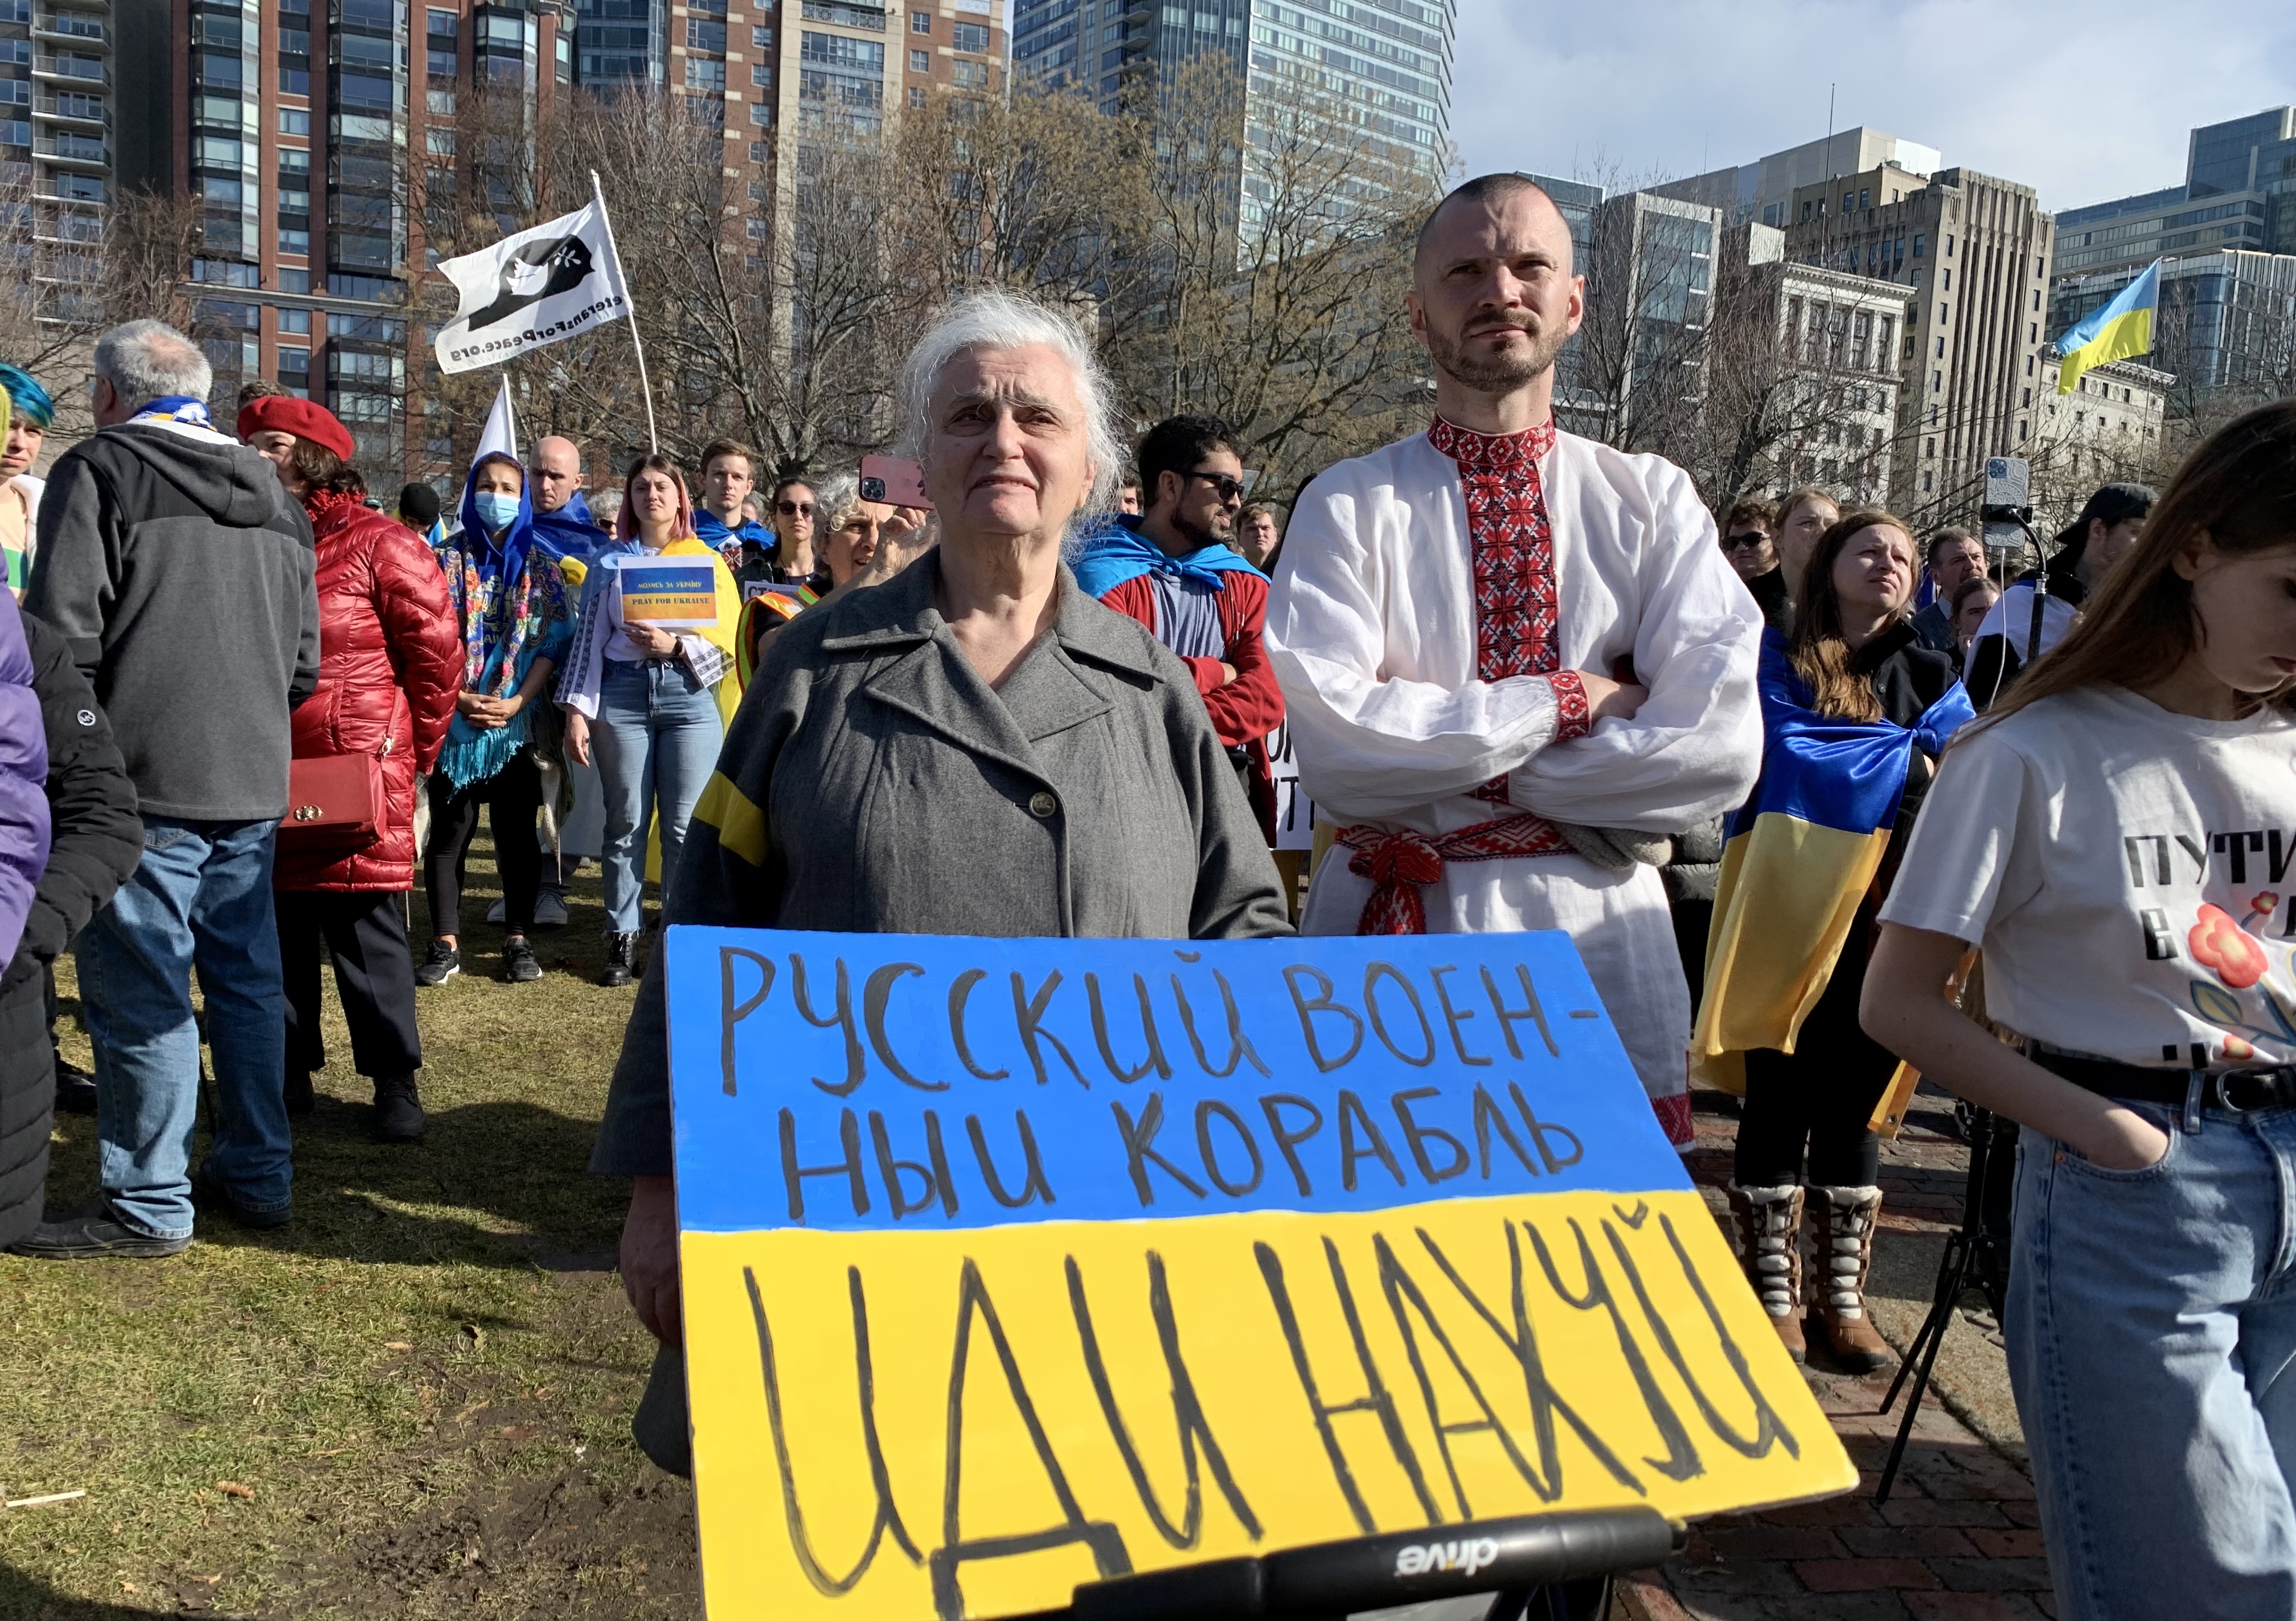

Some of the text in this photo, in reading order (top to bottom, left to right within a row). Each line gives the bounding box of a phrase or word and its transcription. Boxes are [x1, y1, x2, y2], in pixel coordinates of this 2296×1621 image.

[719, 945, 1598, 1098] РУССКИЙ ВОЕН-
[1110, 1079, 1584, 1206] КОРАБЛЬ
[743, 1200, 1801, 1620] ИДИ НАХУЙ
[1396, 1537, 1499, 1578] drive
